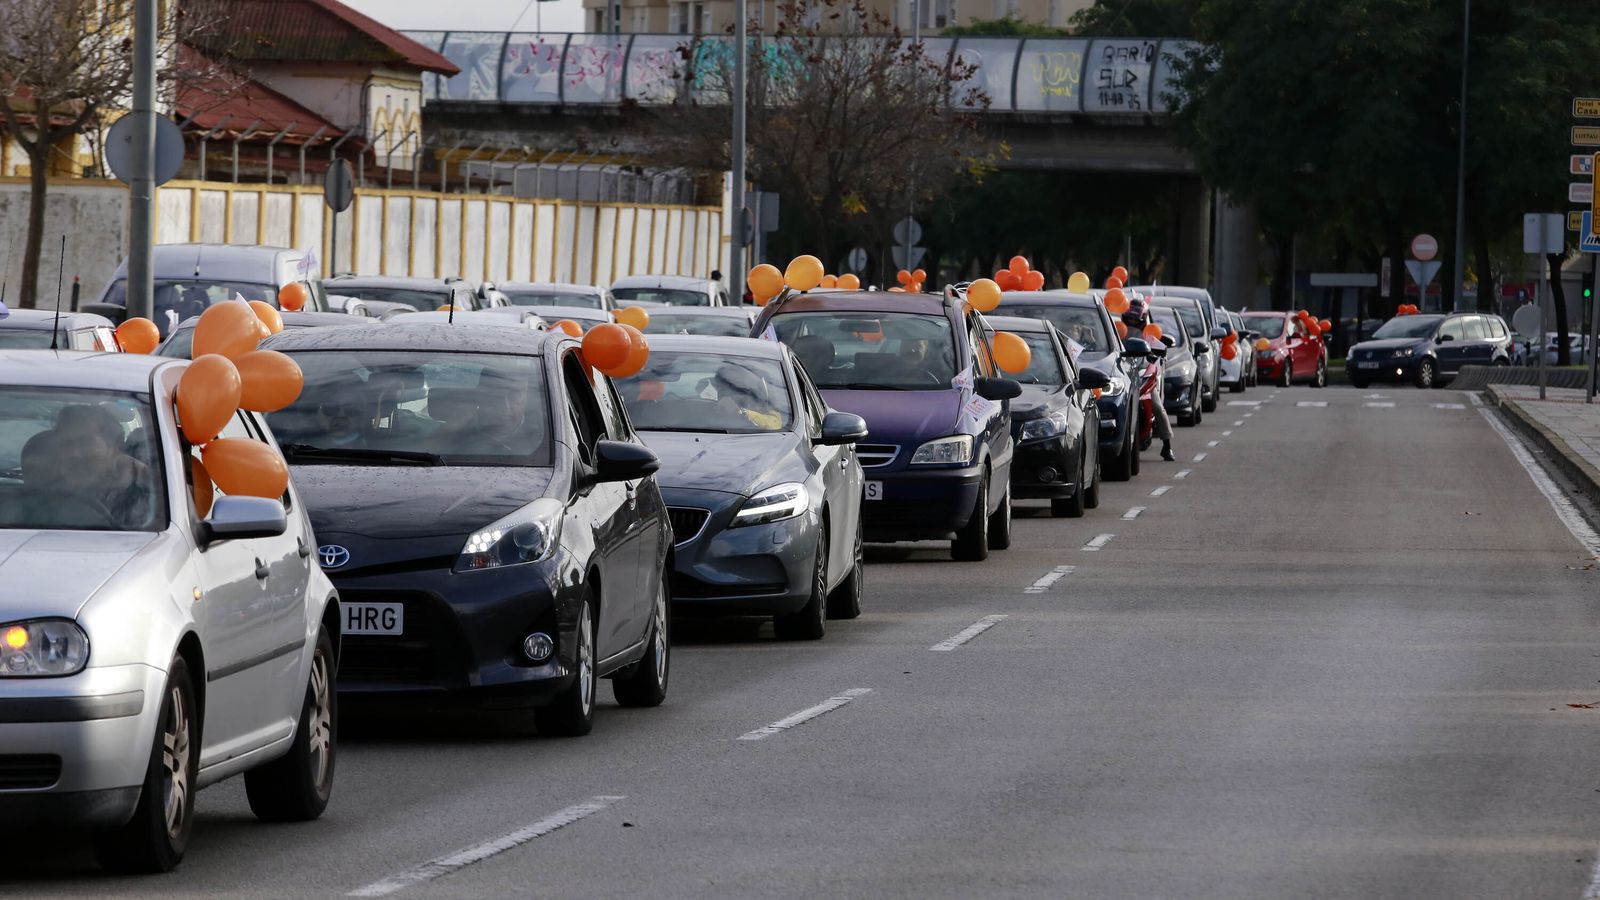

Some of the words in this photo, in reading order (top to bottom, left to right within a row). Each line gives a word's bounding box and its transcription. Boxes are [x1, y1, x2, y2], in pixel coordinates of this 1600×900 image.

[1577, 106, 1598, 115] Casa
[868, 483, 877, 497] S
[348, 606, 396, 630] HRG
